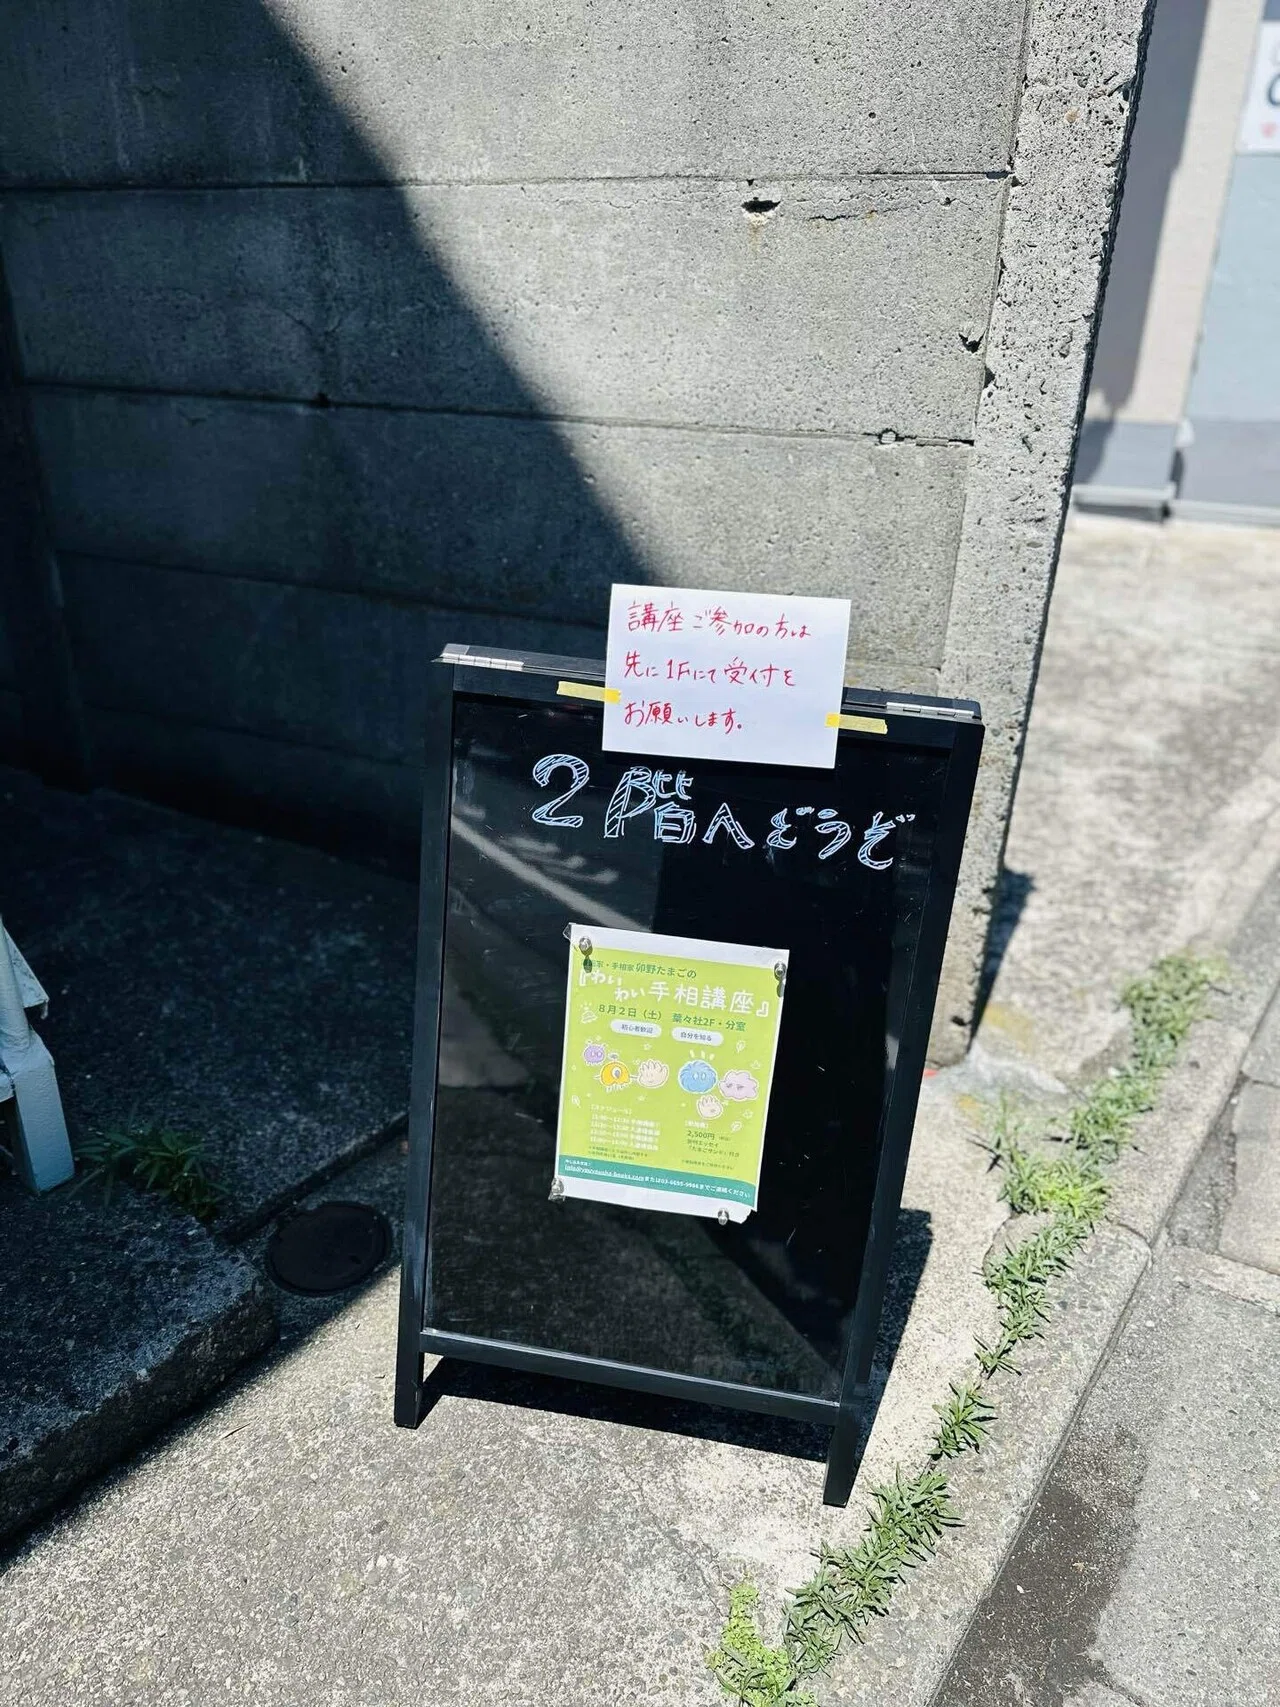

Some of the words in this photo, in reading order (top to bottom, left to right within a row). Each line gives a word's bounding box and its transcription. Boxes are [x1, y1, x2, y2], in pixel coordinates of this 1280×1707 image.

[627, 600, 812, 639] 講座ご参加の方は
[623, 650, 796, 688] 先に1Fにて受付を
[624, 700, 743, 734] お願いします。
[532, 753, 916, 870] 2階へどうぞ
[687, 1130, 715, 1140] 2,500円
